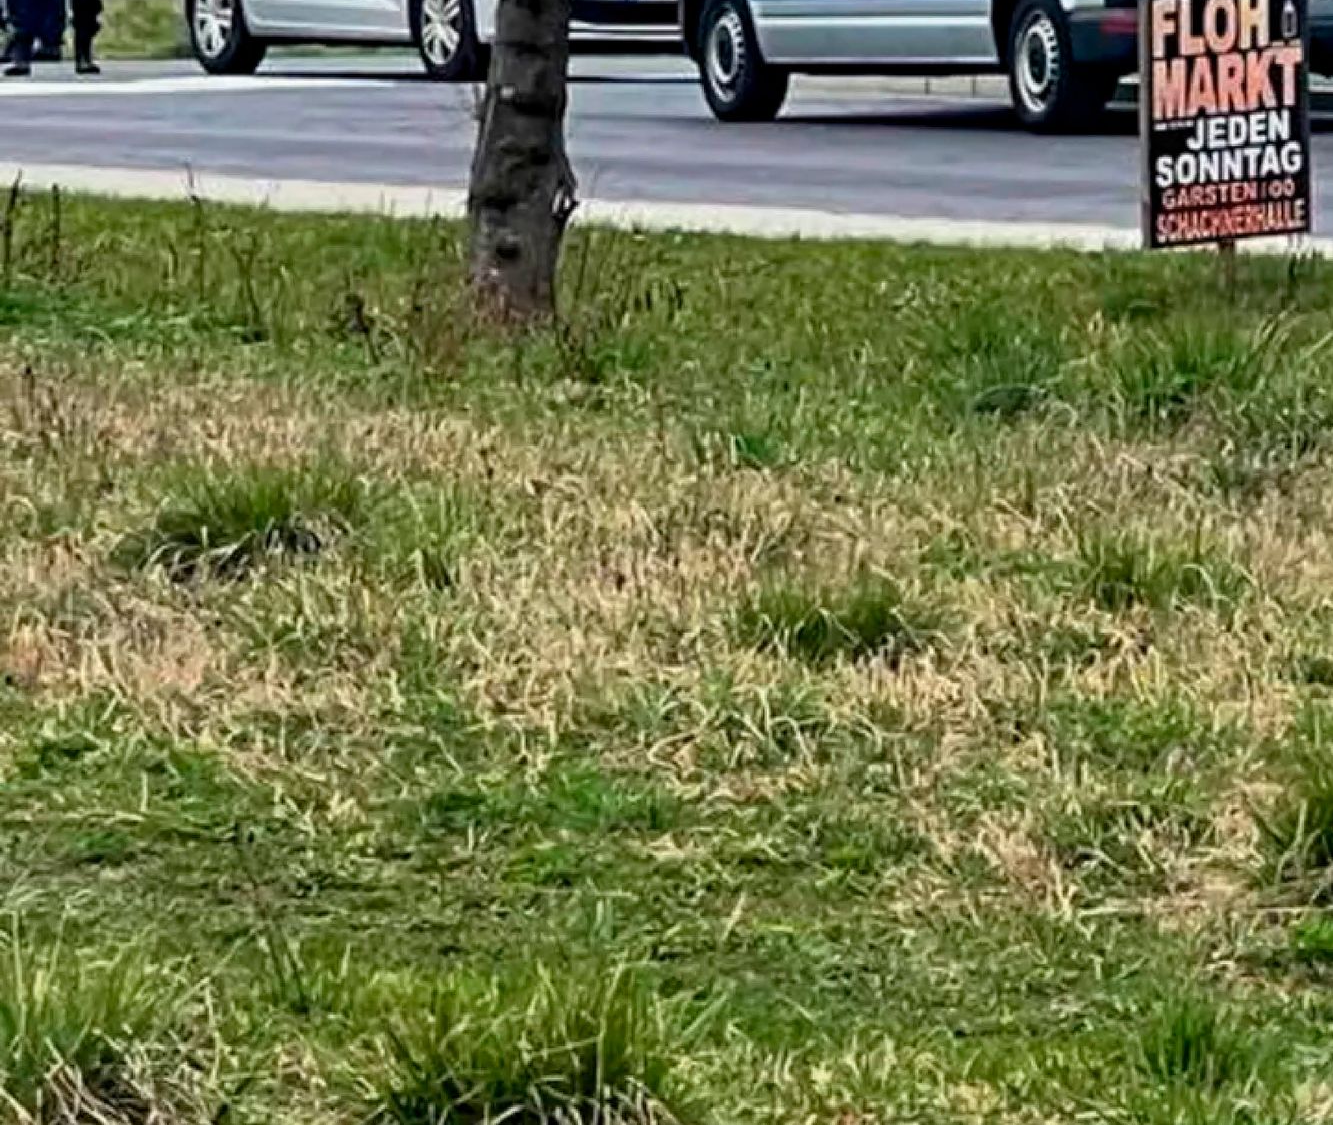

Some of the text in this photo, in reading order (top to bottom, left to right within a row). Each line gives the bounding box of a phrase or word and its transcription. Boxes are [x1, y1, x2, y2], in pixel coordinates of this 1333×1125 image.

[1152, 45, 1303, 120] MARKT
[1186, 109, 1290, 150] JEDEN
[1155, 141, 1302, 187] SONNTAG
[1162, 181, 1258, 209] GARSTEN
